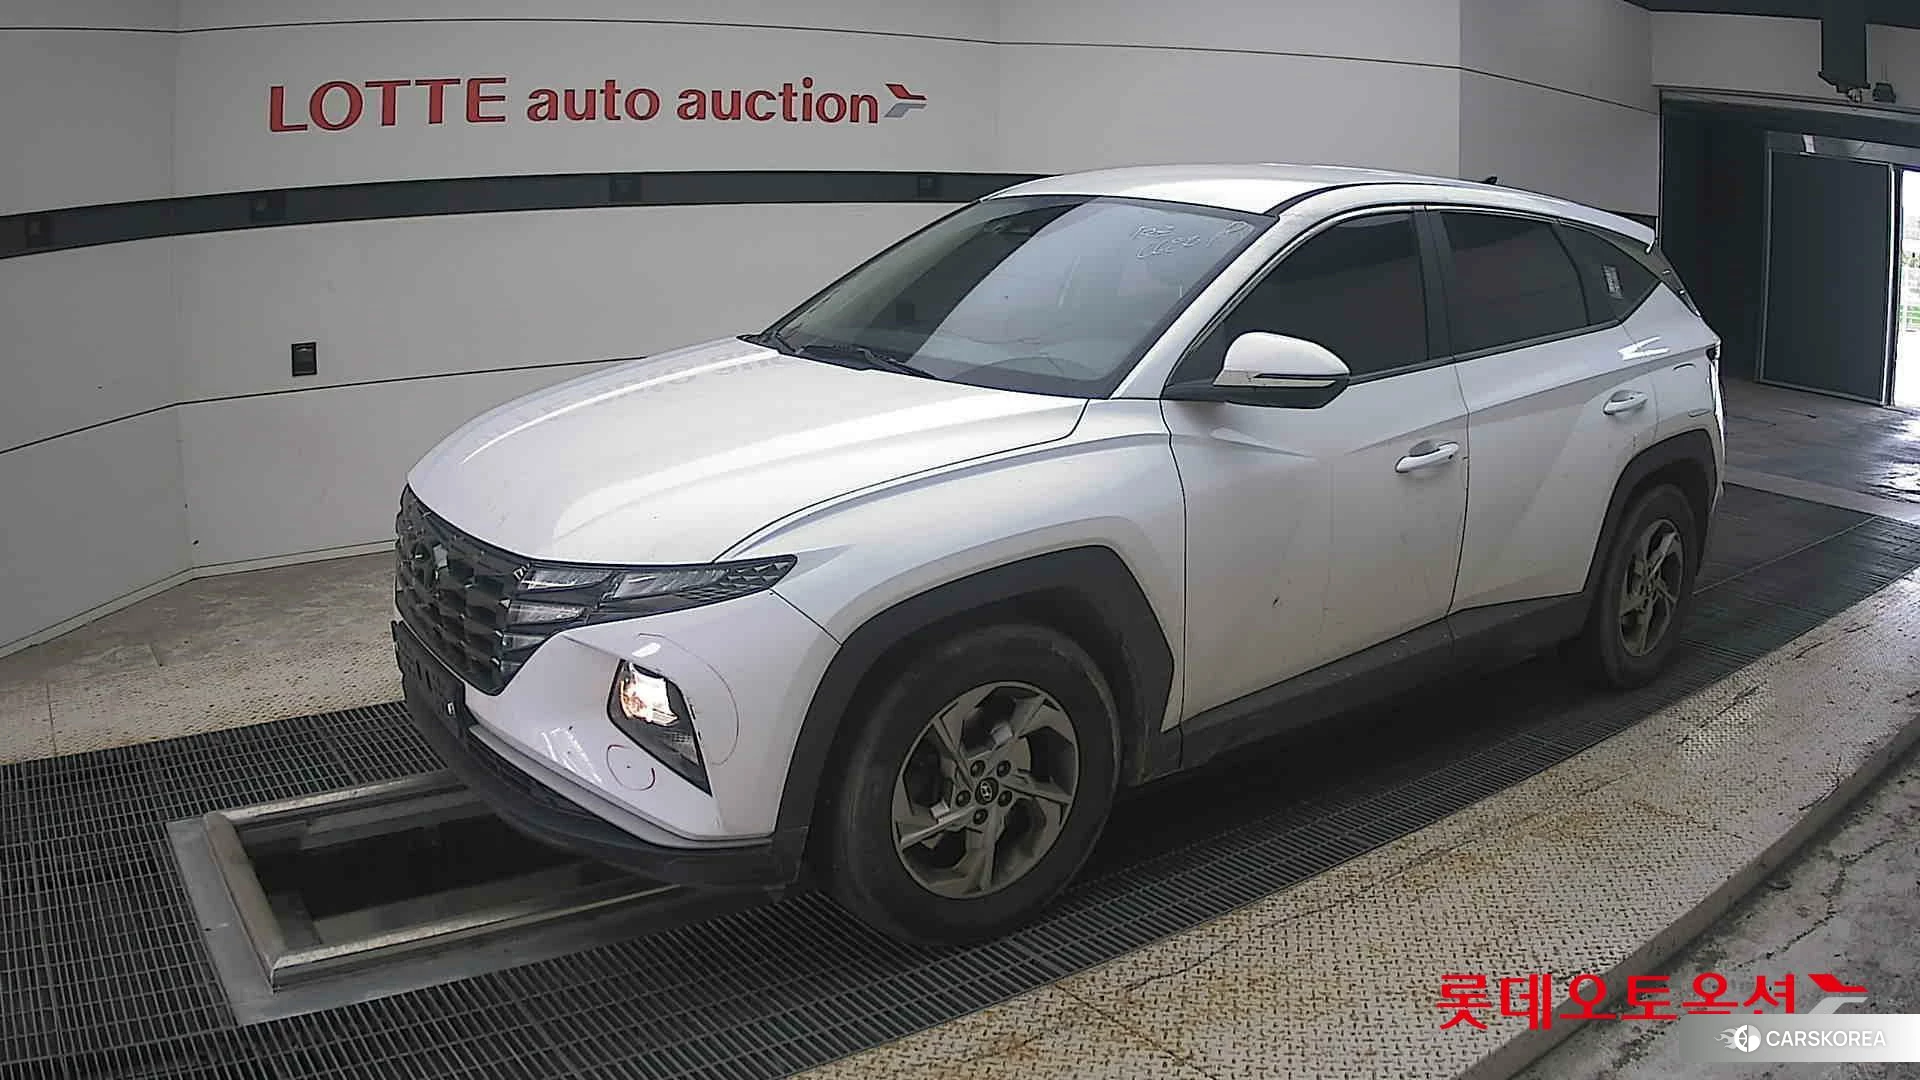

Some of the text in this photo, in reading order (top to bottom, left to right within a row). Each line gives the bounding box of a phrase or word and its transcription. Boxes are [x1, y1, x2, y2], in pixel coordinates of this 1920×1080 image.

[269, 76, 880, 132] LOTTE auto auction
